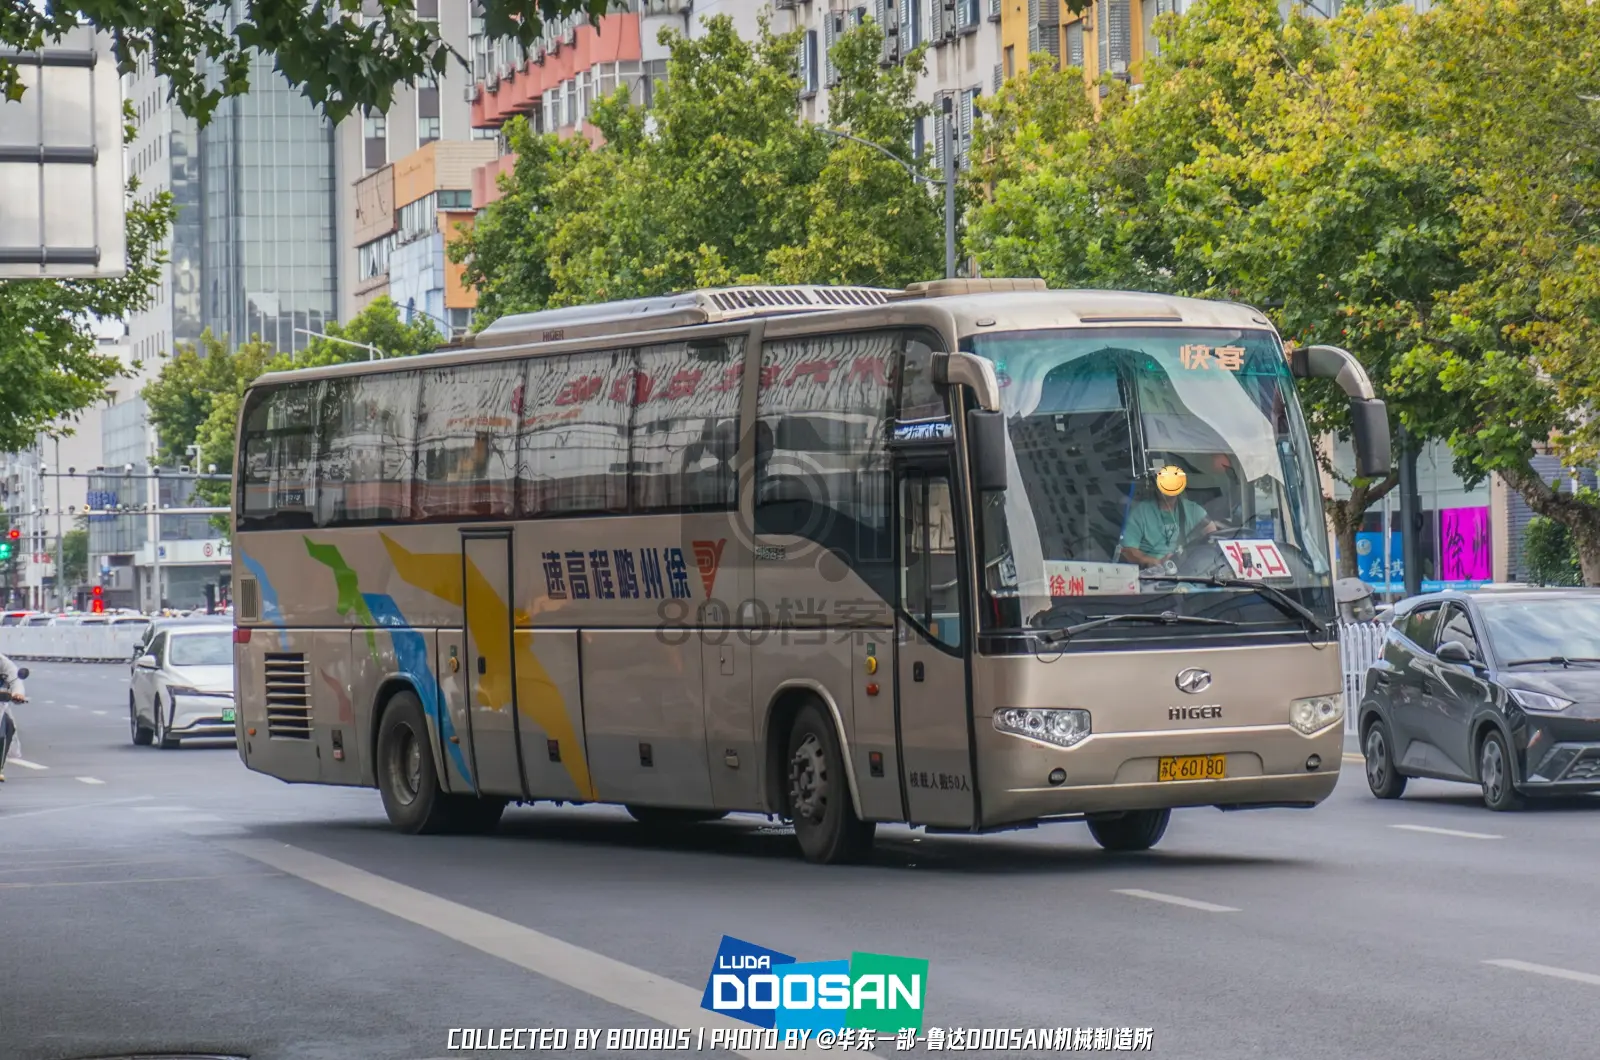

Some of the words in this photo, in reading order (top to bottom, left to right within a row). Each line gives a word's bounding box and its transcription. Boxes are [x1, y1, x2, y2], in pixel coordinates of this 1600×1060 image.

[1179, 344, 1245, 370] 快客
[1049, 573, 1085, 596] 徐州
[1168, 704, 1222, 720] HIGER
